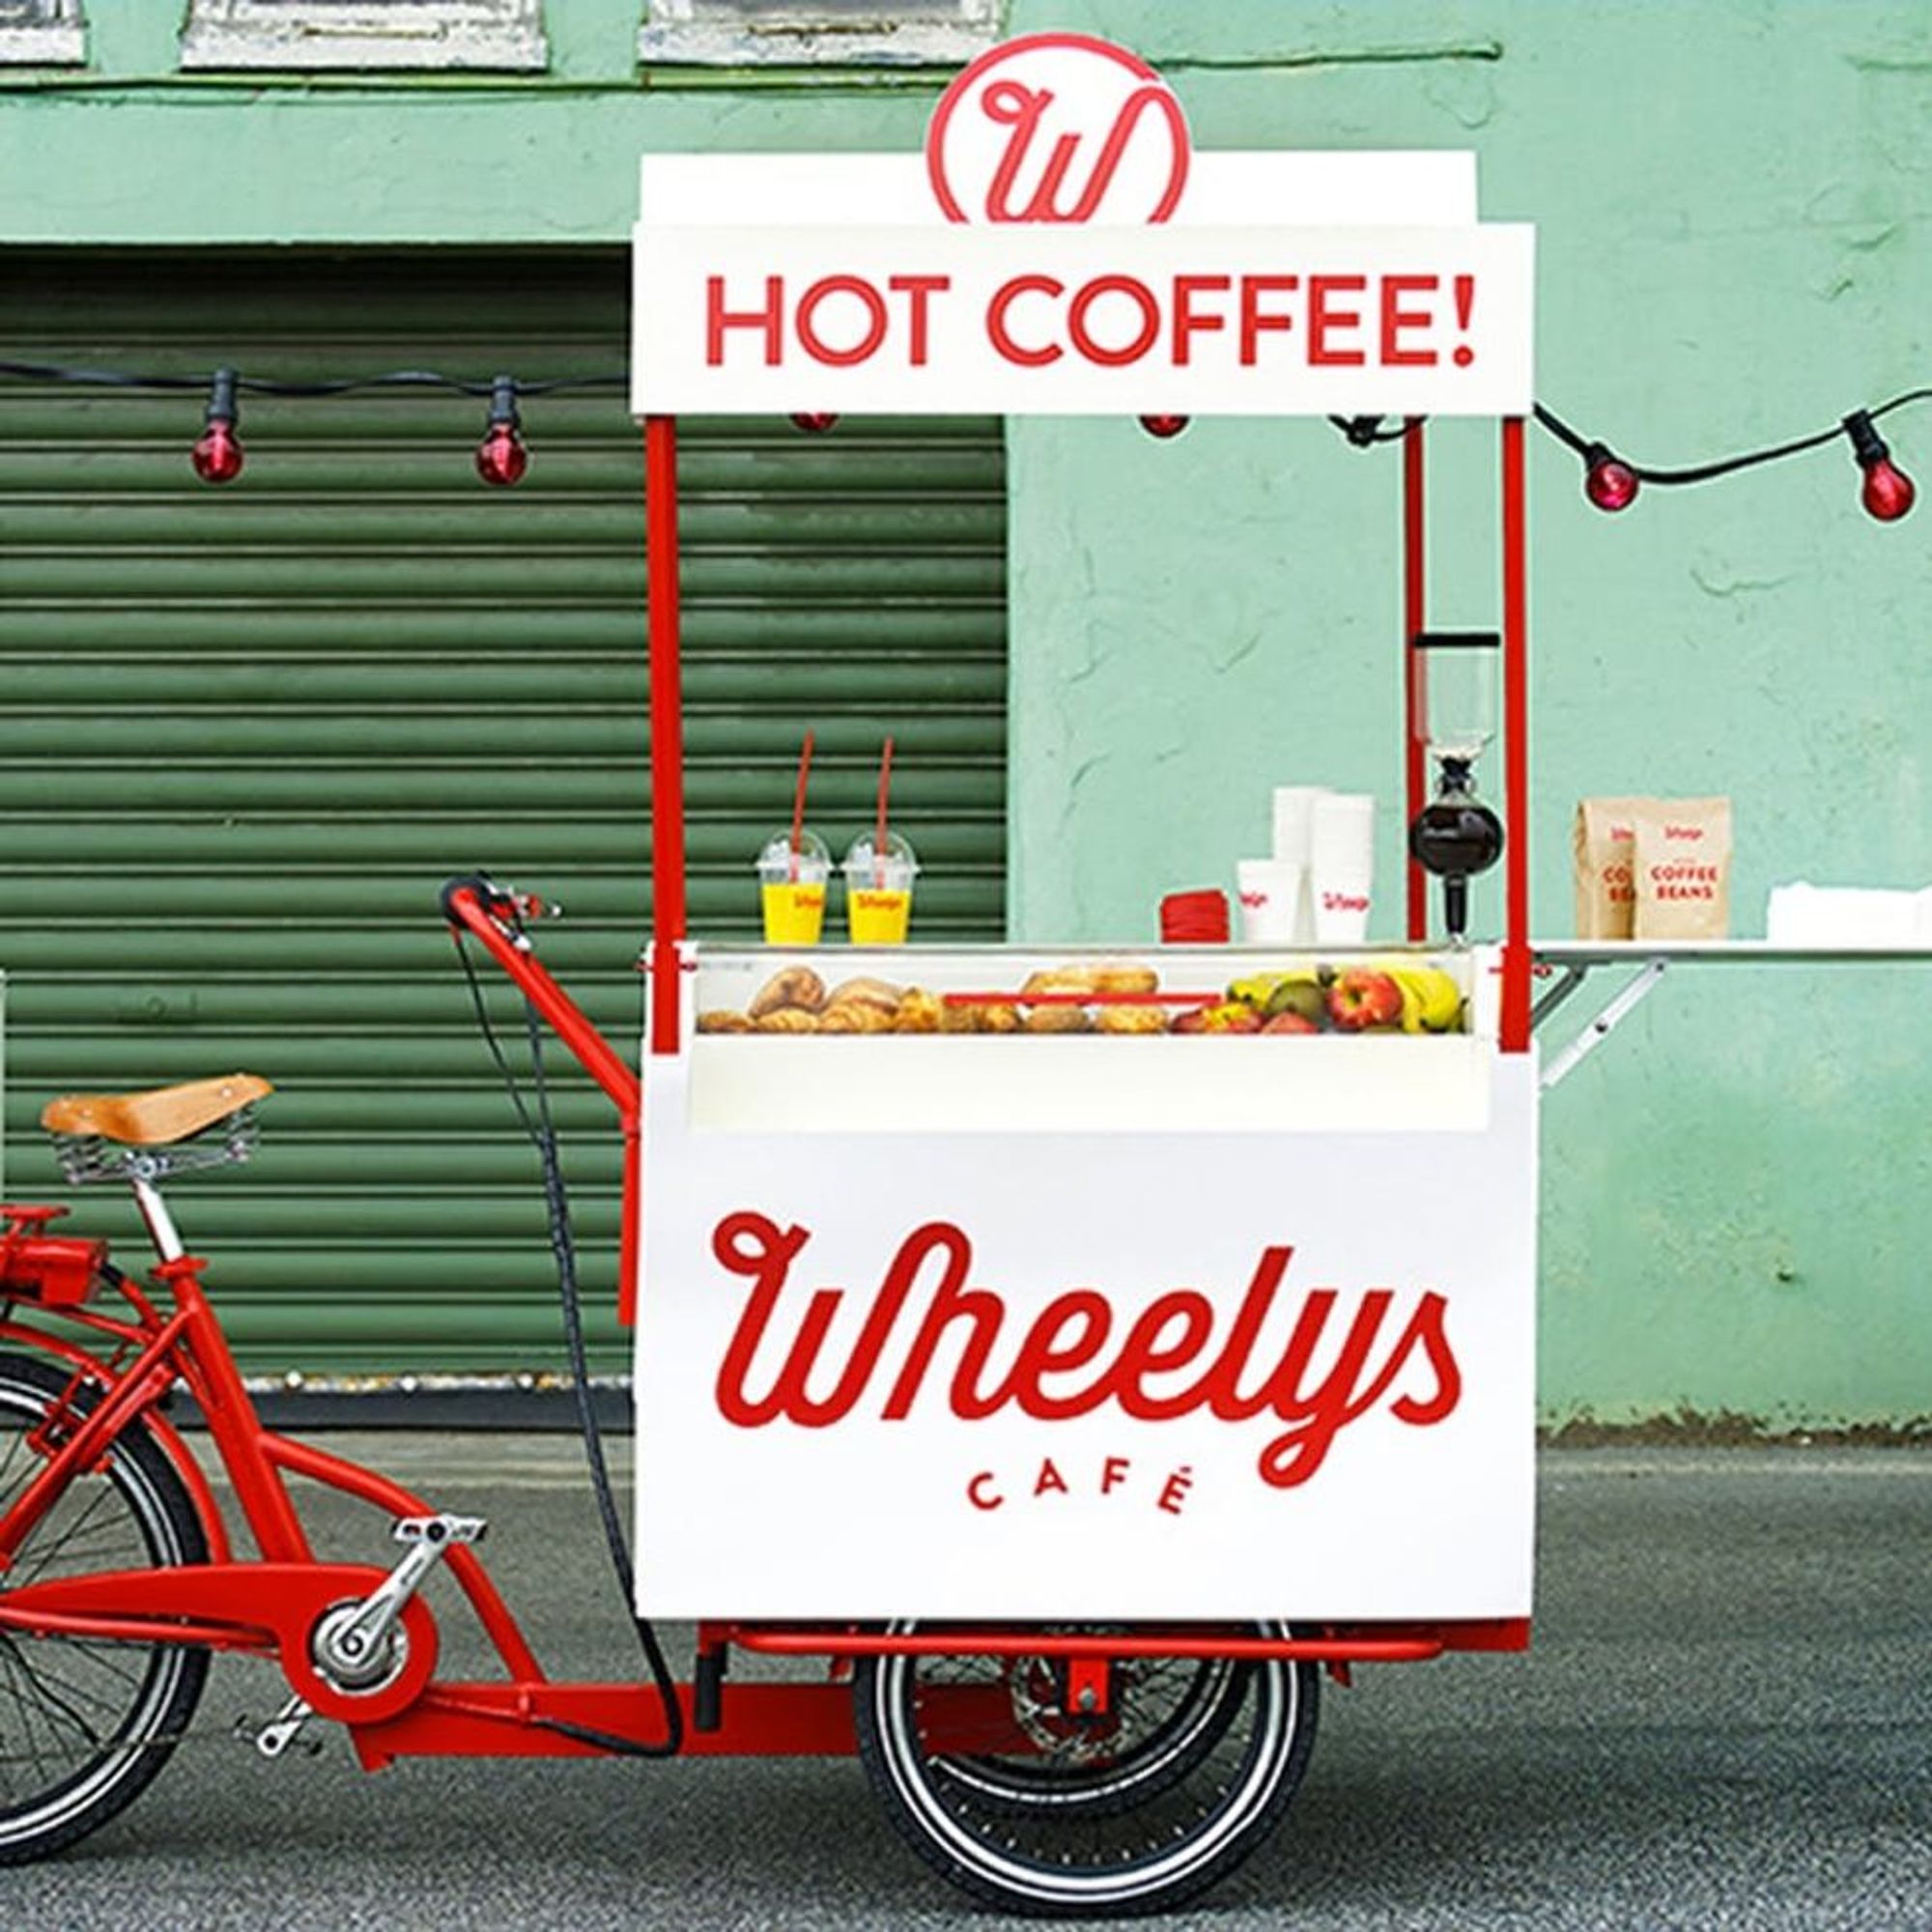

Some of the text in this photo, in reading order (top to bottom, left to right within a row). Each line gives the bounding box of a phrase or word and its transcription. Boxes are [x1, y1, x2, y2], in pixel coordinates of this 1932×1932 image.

[706, 274, 1474, 368] HOT COFFEE!
[1651, 867, 1718, 882] COFFEE
[1657, 886, 1713, 900] BEANS
[712, 1210, 1462, 1491] Wheelys
[967, 1457, 1194, 1515] CAFÉ
